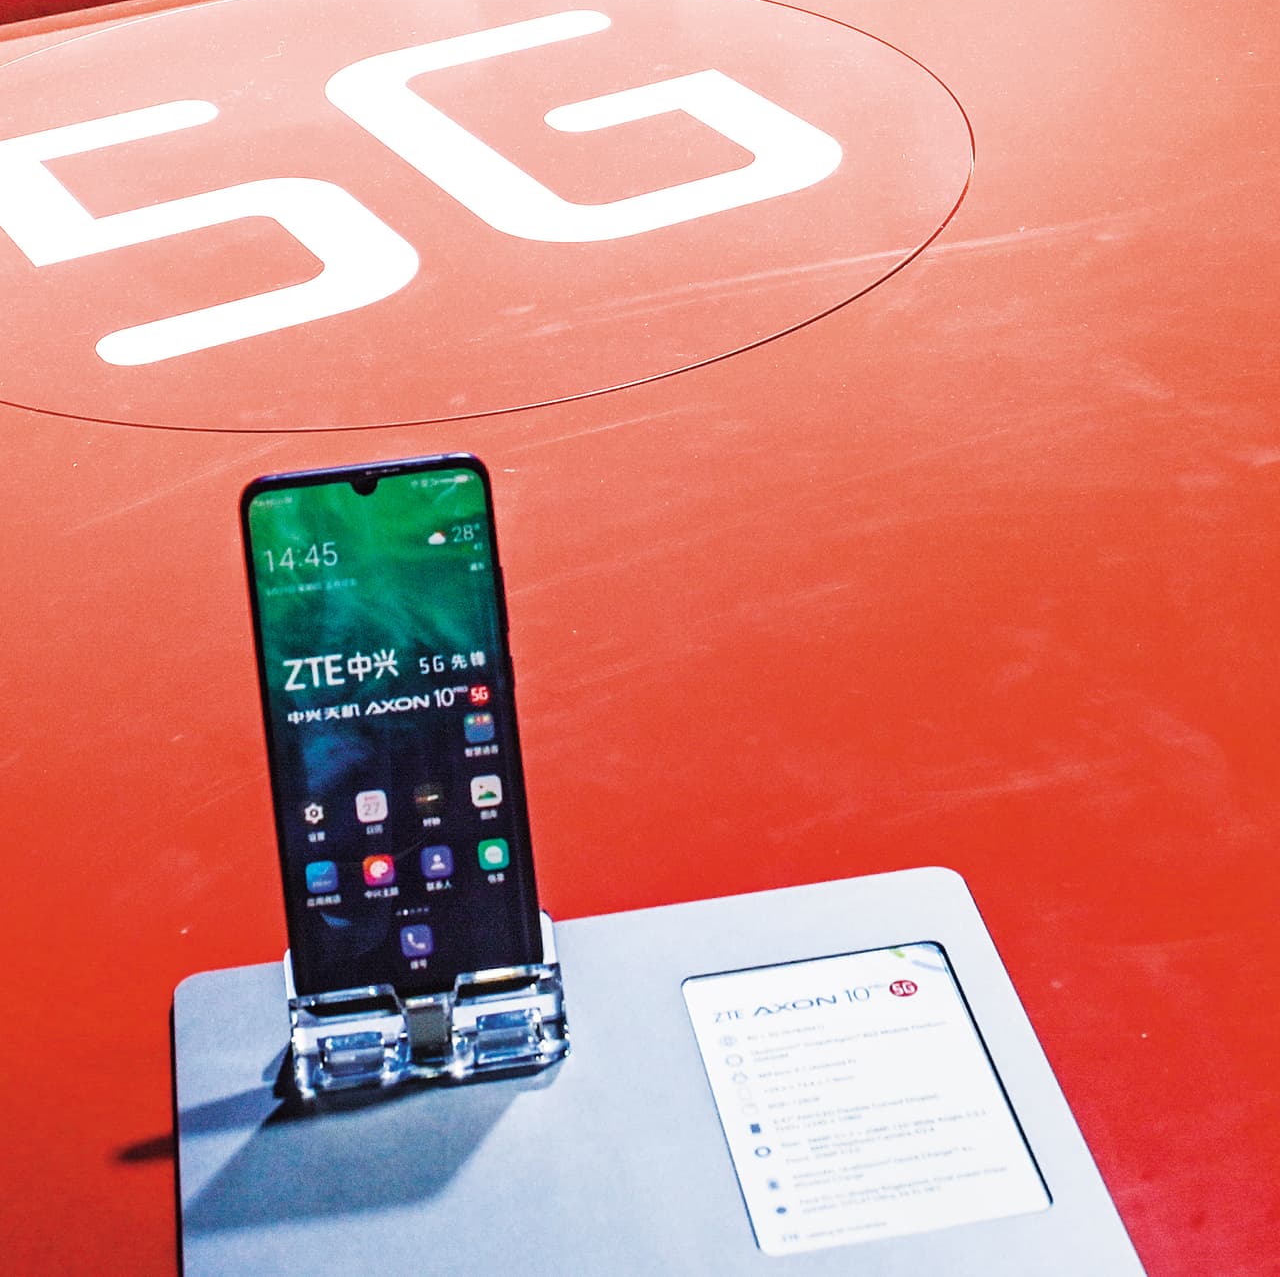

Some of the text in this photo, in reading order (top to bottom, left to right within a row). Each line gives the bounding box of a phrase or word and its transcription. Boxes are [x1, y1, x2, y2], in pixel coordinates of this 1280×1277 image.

[264, 541, 338, 572] 14:45
[365, 694, 430, 716] AXON
[470, 685, 489, 702] 5G
[752, 993, 838, 1018] AXON
[892, 981, 916, 997] 5G
